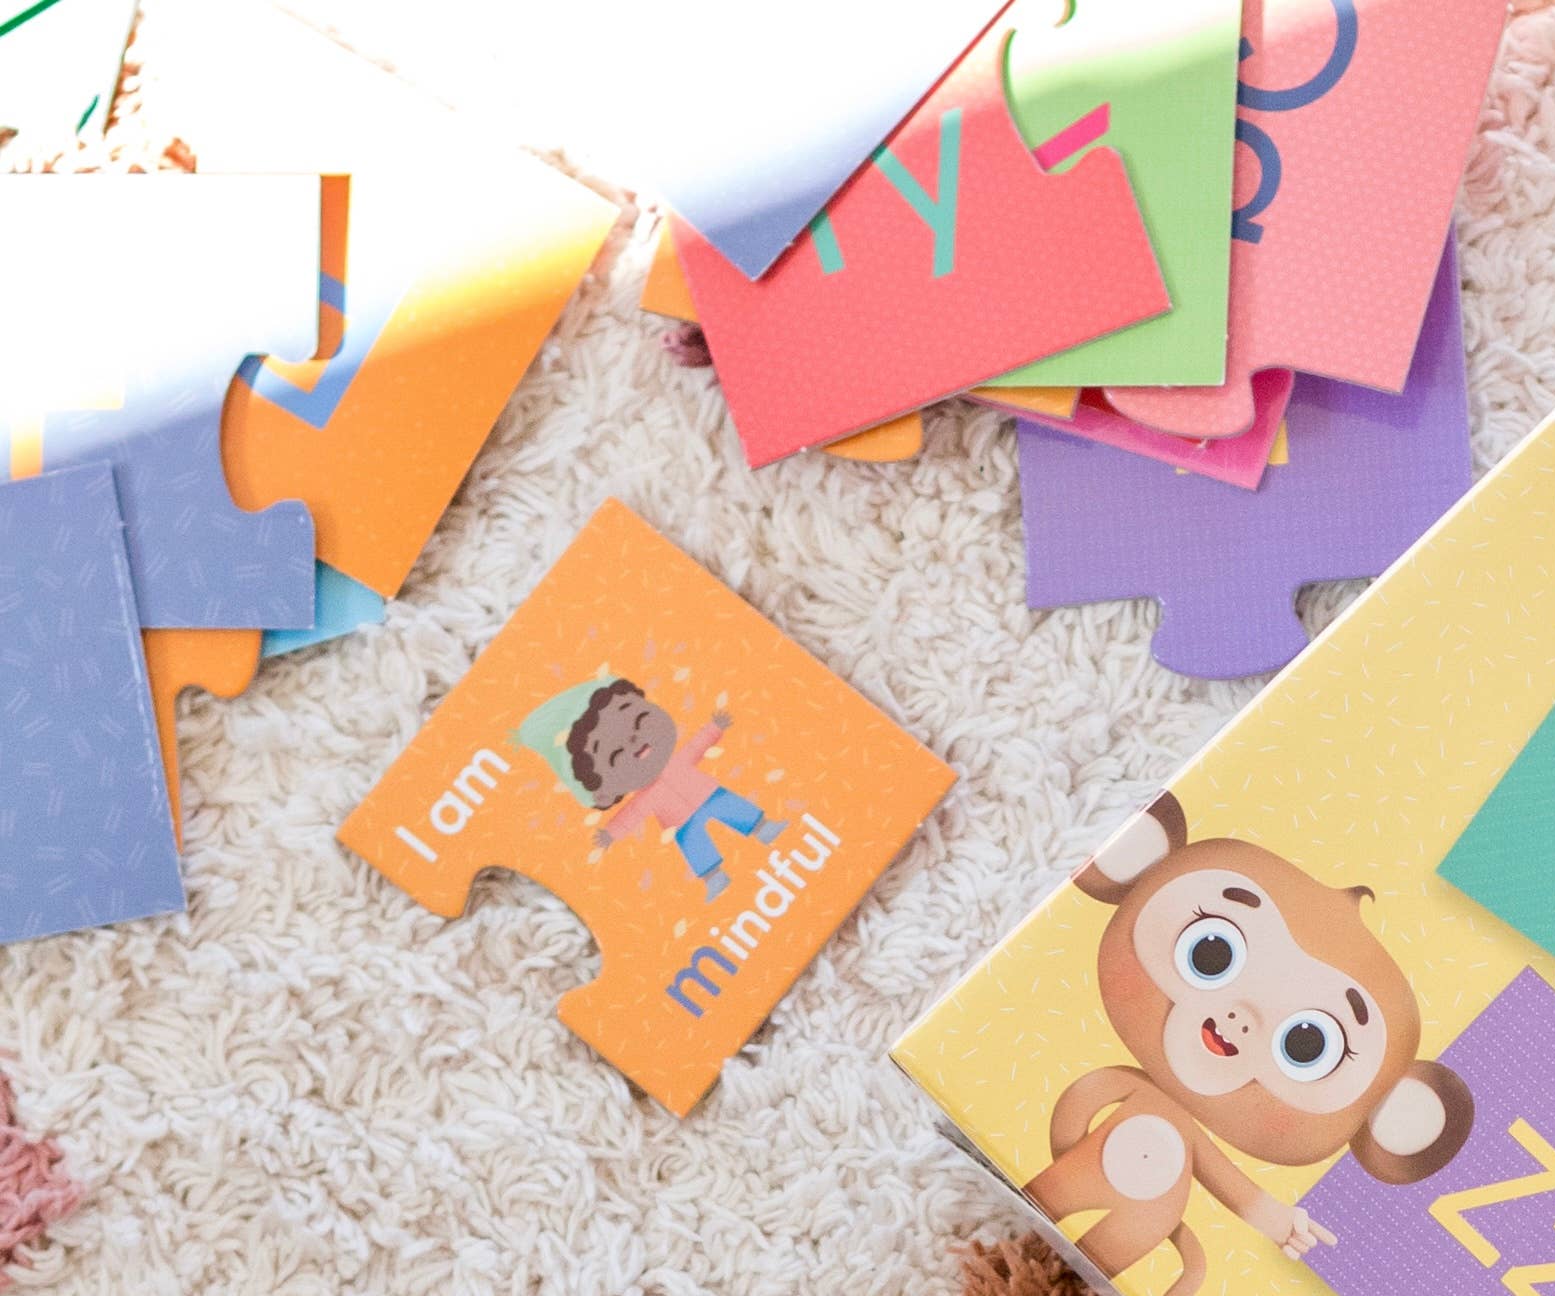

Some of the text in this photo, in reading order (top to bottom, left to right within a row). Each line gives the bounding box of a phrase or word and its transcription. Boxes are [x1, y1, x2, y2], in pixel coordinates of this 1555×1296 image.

[394, 746, 511, 863] I am
[663, 812, 842, 1019] mindful
